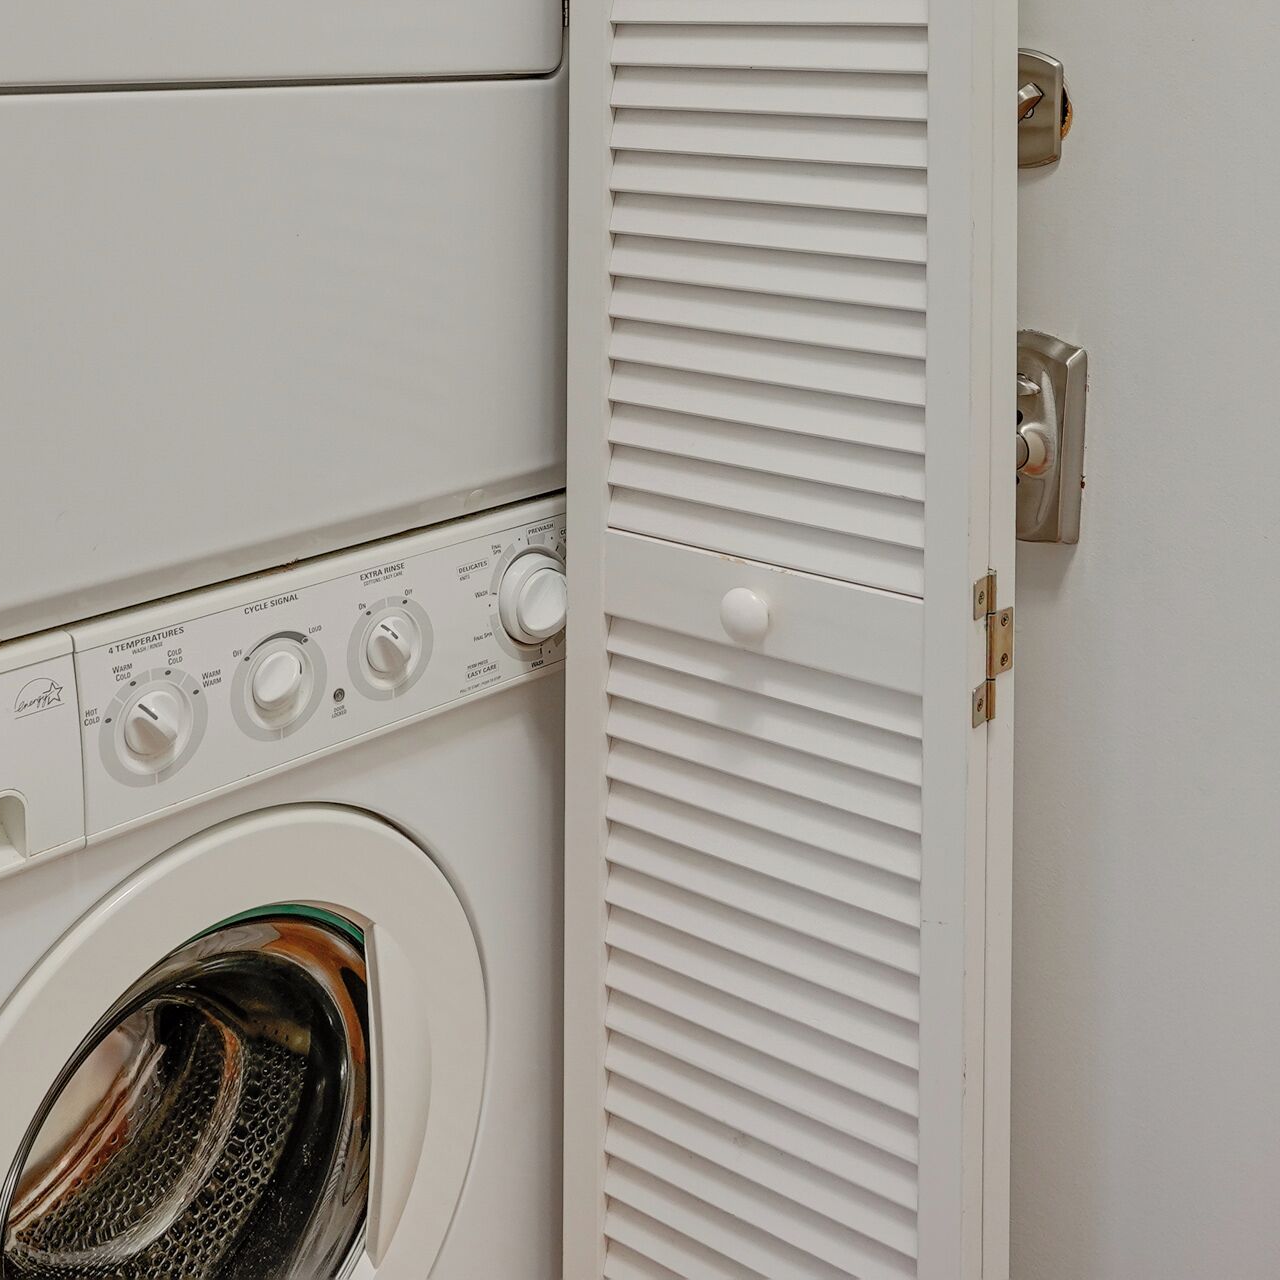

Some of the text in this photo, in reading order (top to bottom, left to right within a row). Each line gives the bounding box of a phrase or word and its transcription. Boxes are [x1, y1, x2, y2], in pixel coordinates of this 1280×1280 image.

[528, 523, 554, 535] PREWASH
[360, 562, 406, 581] EXTRA RINSE
[458, 560, 488, 574] DELICATES
[244, 593, 299, 615] CYCLE SIGNAL
[108, 626, 185, 655] 4 TEMPERATURES
[467, 664, 497, 679] EASY CARE
